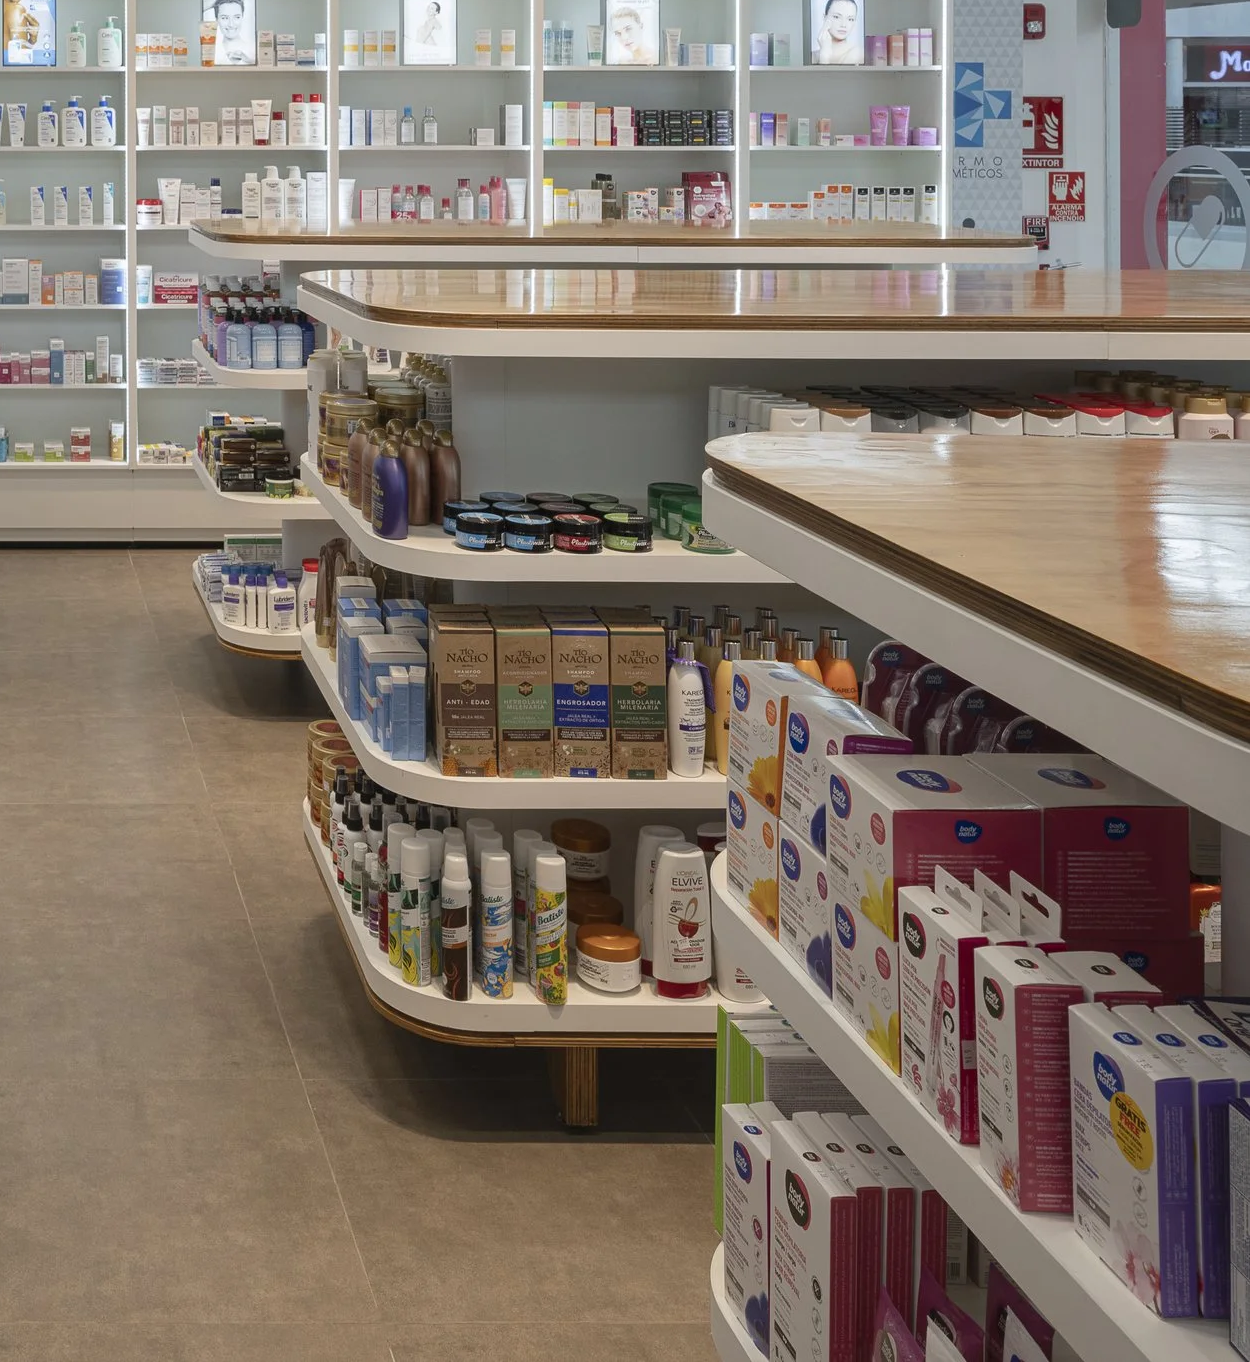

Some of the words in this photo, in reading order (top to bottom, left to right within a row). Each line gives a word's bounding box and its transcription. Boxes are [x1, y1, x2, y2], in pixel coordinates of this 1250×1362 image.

[1023, 159, 1060, 167] XTINTOR
[953, 168, 1003, 179] MÉTICOS
[460, 646, 475, 656] TÍO
[573, 647, 588, 656] TÍO
[446, 652, 488, 663] NACHO
[504, 654, 546, 664] NACHO
[559, 653, 602, 664] NACHO
[617, 654, 660, 665] NACHO
[556, 699, 607, 707] ENGROSADOR
[958, 825, 978, 834] body
[671, 876, 703, 887] ELVIVE
[537, 907, 565, 926] Batiste
[1097, 1063, 1117, 1085] body
[1115, 1096, 1147, 1134] GRATIS
[1119, 1113, 1141, 1137] FREE
